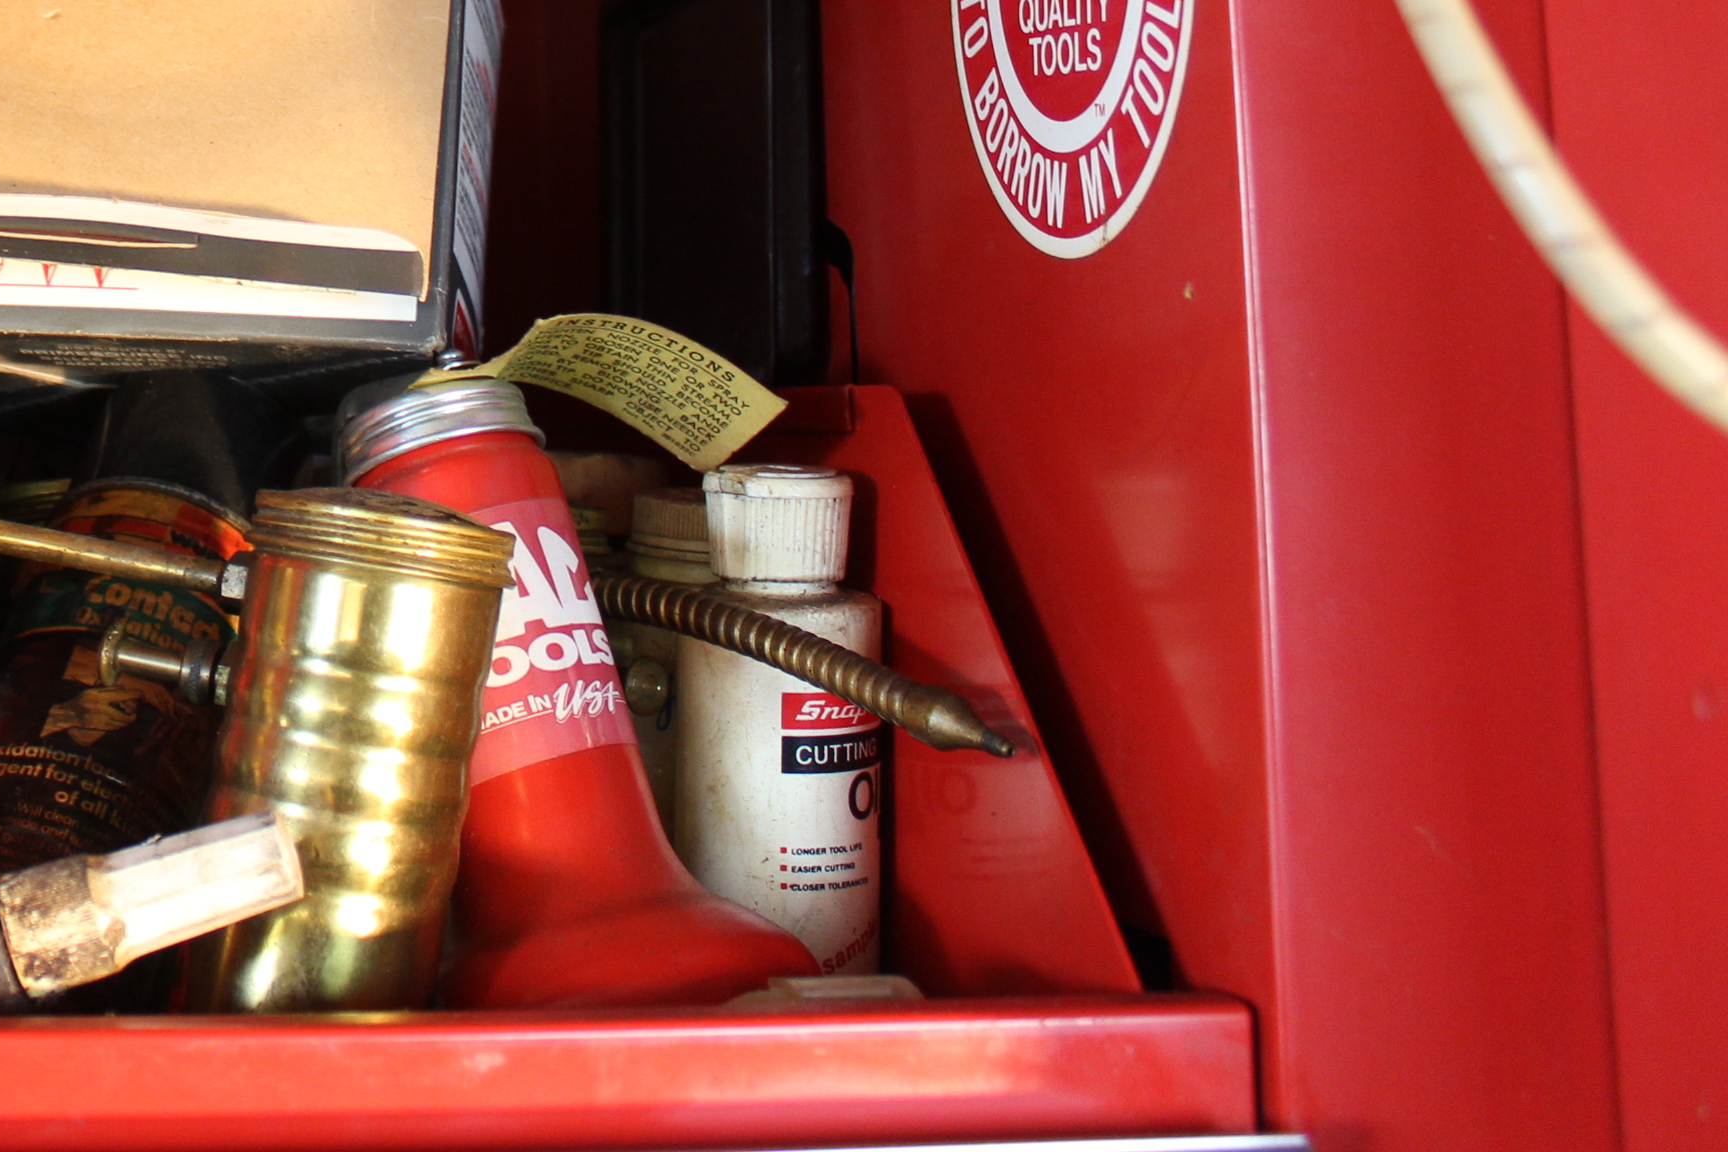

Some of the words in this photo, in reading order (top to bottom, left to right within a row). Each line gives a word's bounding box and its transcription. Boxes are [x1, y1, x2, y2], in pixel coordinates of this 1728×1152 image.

[1028, 31, 1103, 77] TOOLS
[973, 66, 1068, 230] BORROW
[1078, 127, 1124, 225] MY
[556, 318, 736, 383] INSTRUCTIONS
[608, 332, 663, 357] NOZZLE
[671, 356, 699, 376] FOR
[707, 379, 751, 409] SPRAY
[613, 359, 668, 388] SHOULD
[646, 362, 678, 384] THIN
[649, 356, 681, 376] ONE
[685, 376, 707, 390] OR
[712, 392, 743, 417] TWO
[635, 377, 688, 410] NOZZLE
[691, 412, 721, 435] AND
[638, 398, 663, 416] USE
[679, 414, 716, 443] BACK
[490, 520, 603, 642] AC
[484, 628, 615, 688] OOLS
[553, 679, 621, 724] USA
[795, 736, 877, 766] CUTTING
[44, 762, 79, 785] for
[55, 790, 81, 806] of
[791, 845, 827, 857] LONGER
[791, 864, 822, 875] EASIER
[824, 862, 856, 873] CUTTING
[790, 882, 826, 892] CLOSER
